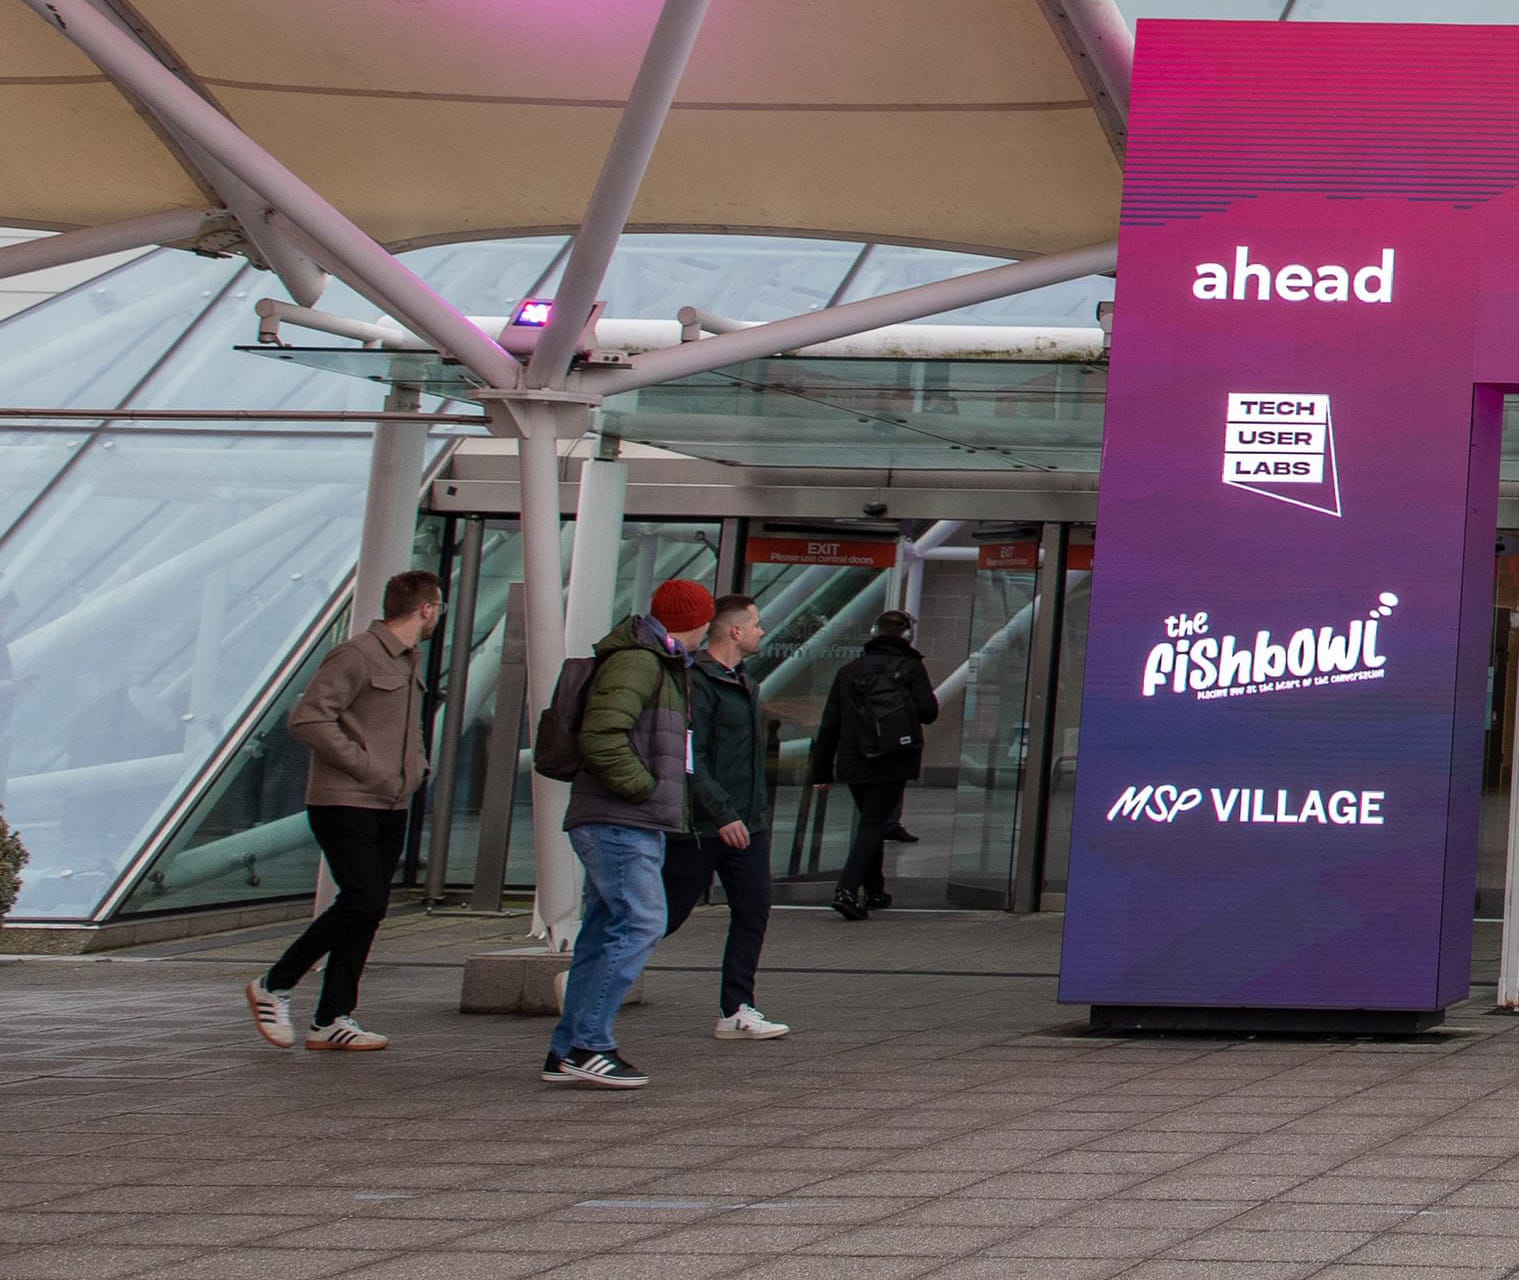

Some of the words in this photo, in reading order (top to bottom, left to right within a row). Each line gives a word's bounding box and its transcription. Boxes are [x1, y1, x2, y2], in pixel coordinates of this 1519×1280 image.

[1193, 246, 1395, 303] ahead
[1240, 401, 1315, 416] TECH
[1238, 430, 1312, 446] USER
[1235, 460, 1311, 476] LABS
[808, 542, 840, 556] EXIT
[770, 552, 800, 562] Please
[817, 555, 848, 564] central
[848, 555, 874, 565] doors
[1164, 611, 1209, 638] the
[1107, 784, 1202, 823] MSP
[1210, 788, 1385, 825] VILLAGE
